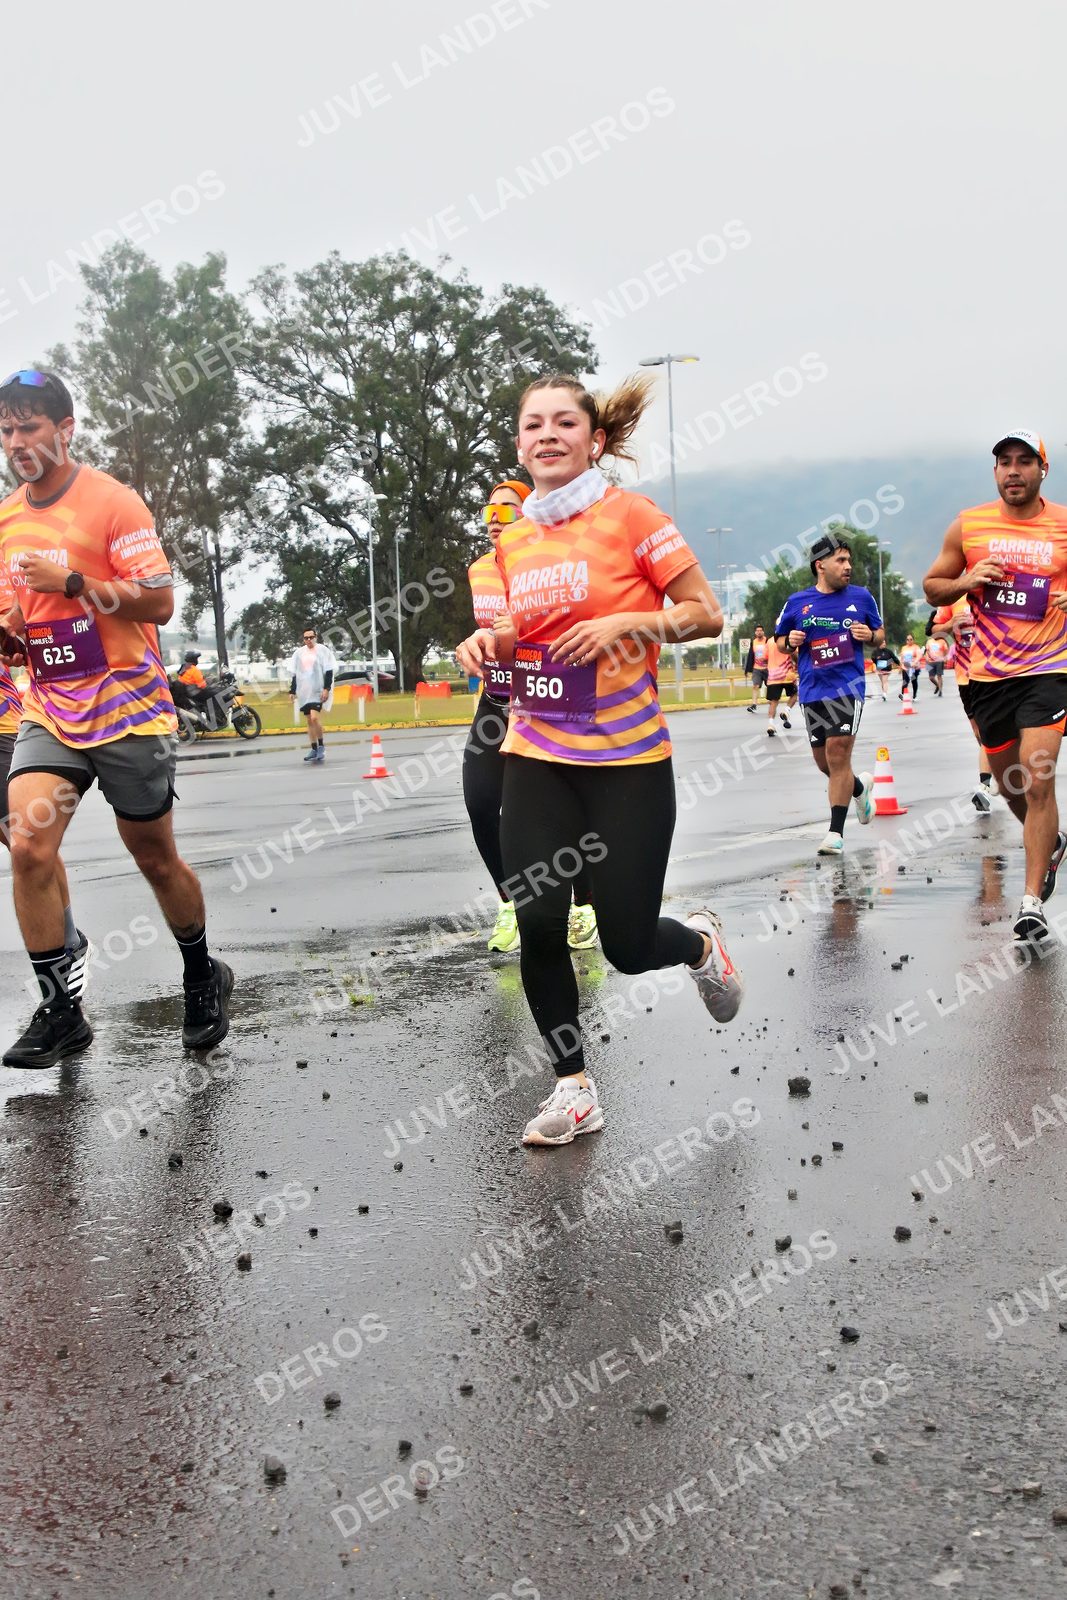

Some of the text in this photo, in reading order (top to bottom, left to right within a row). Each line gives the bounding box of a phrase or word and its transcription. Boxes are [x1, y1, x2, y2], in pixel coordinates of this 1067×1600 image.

[988, 539, 1053, 557] CARRERA
[511, 560, 589, 597] CARRERA
[510, 588, 567, 614] OMNILIFE
[996, 590, 1027, 606] 438
[42, 645, 76, 665] 625
[515, 648, 542, 662] CARRERA
[820, 647, 839, 659] 361
[490, 669, 512, 683] 303
[526, 675, 563, 699] 560
